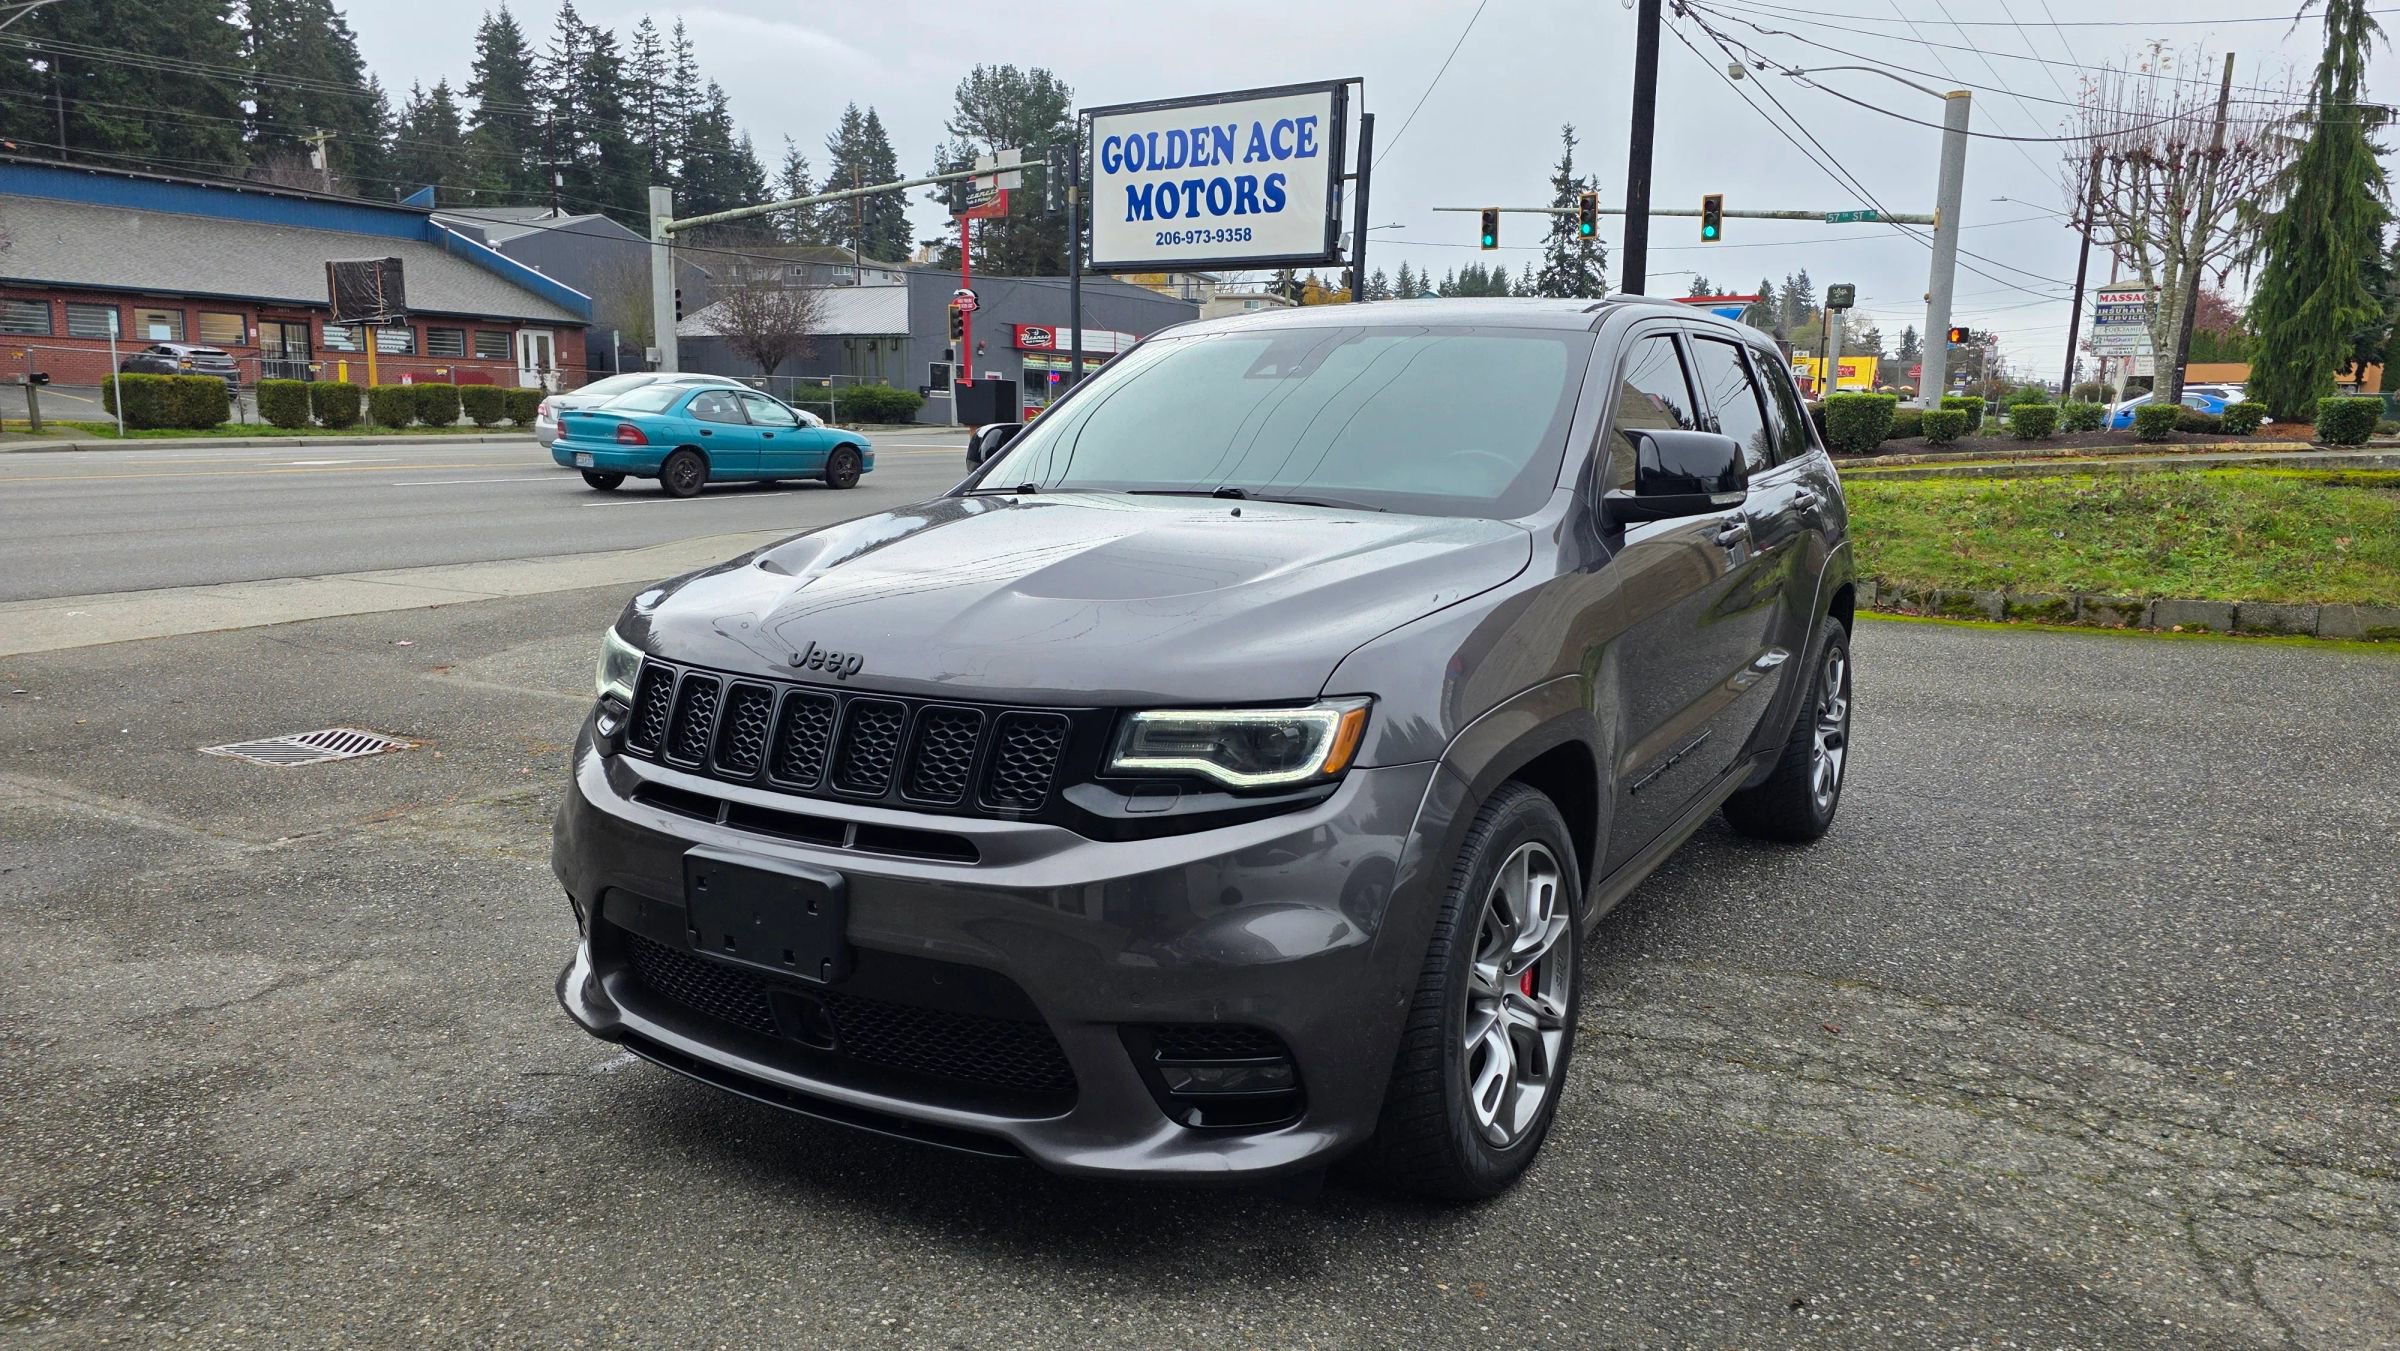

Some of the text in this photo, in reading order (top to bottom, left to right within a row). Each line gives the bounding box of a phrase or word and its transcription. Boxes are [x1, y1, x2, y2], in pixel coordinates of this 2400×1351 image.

[1101, 115, 1319, 175] GOLDEN ACE
[1125, 172, 1287, 222] MOTORS
[1827, 213, 1840, 223] 57
[1852, 211, 1865, 221] ST
[1155, 227, 1252, 246] 206-973-9358
[787, 640, 864, 680] Jeep
